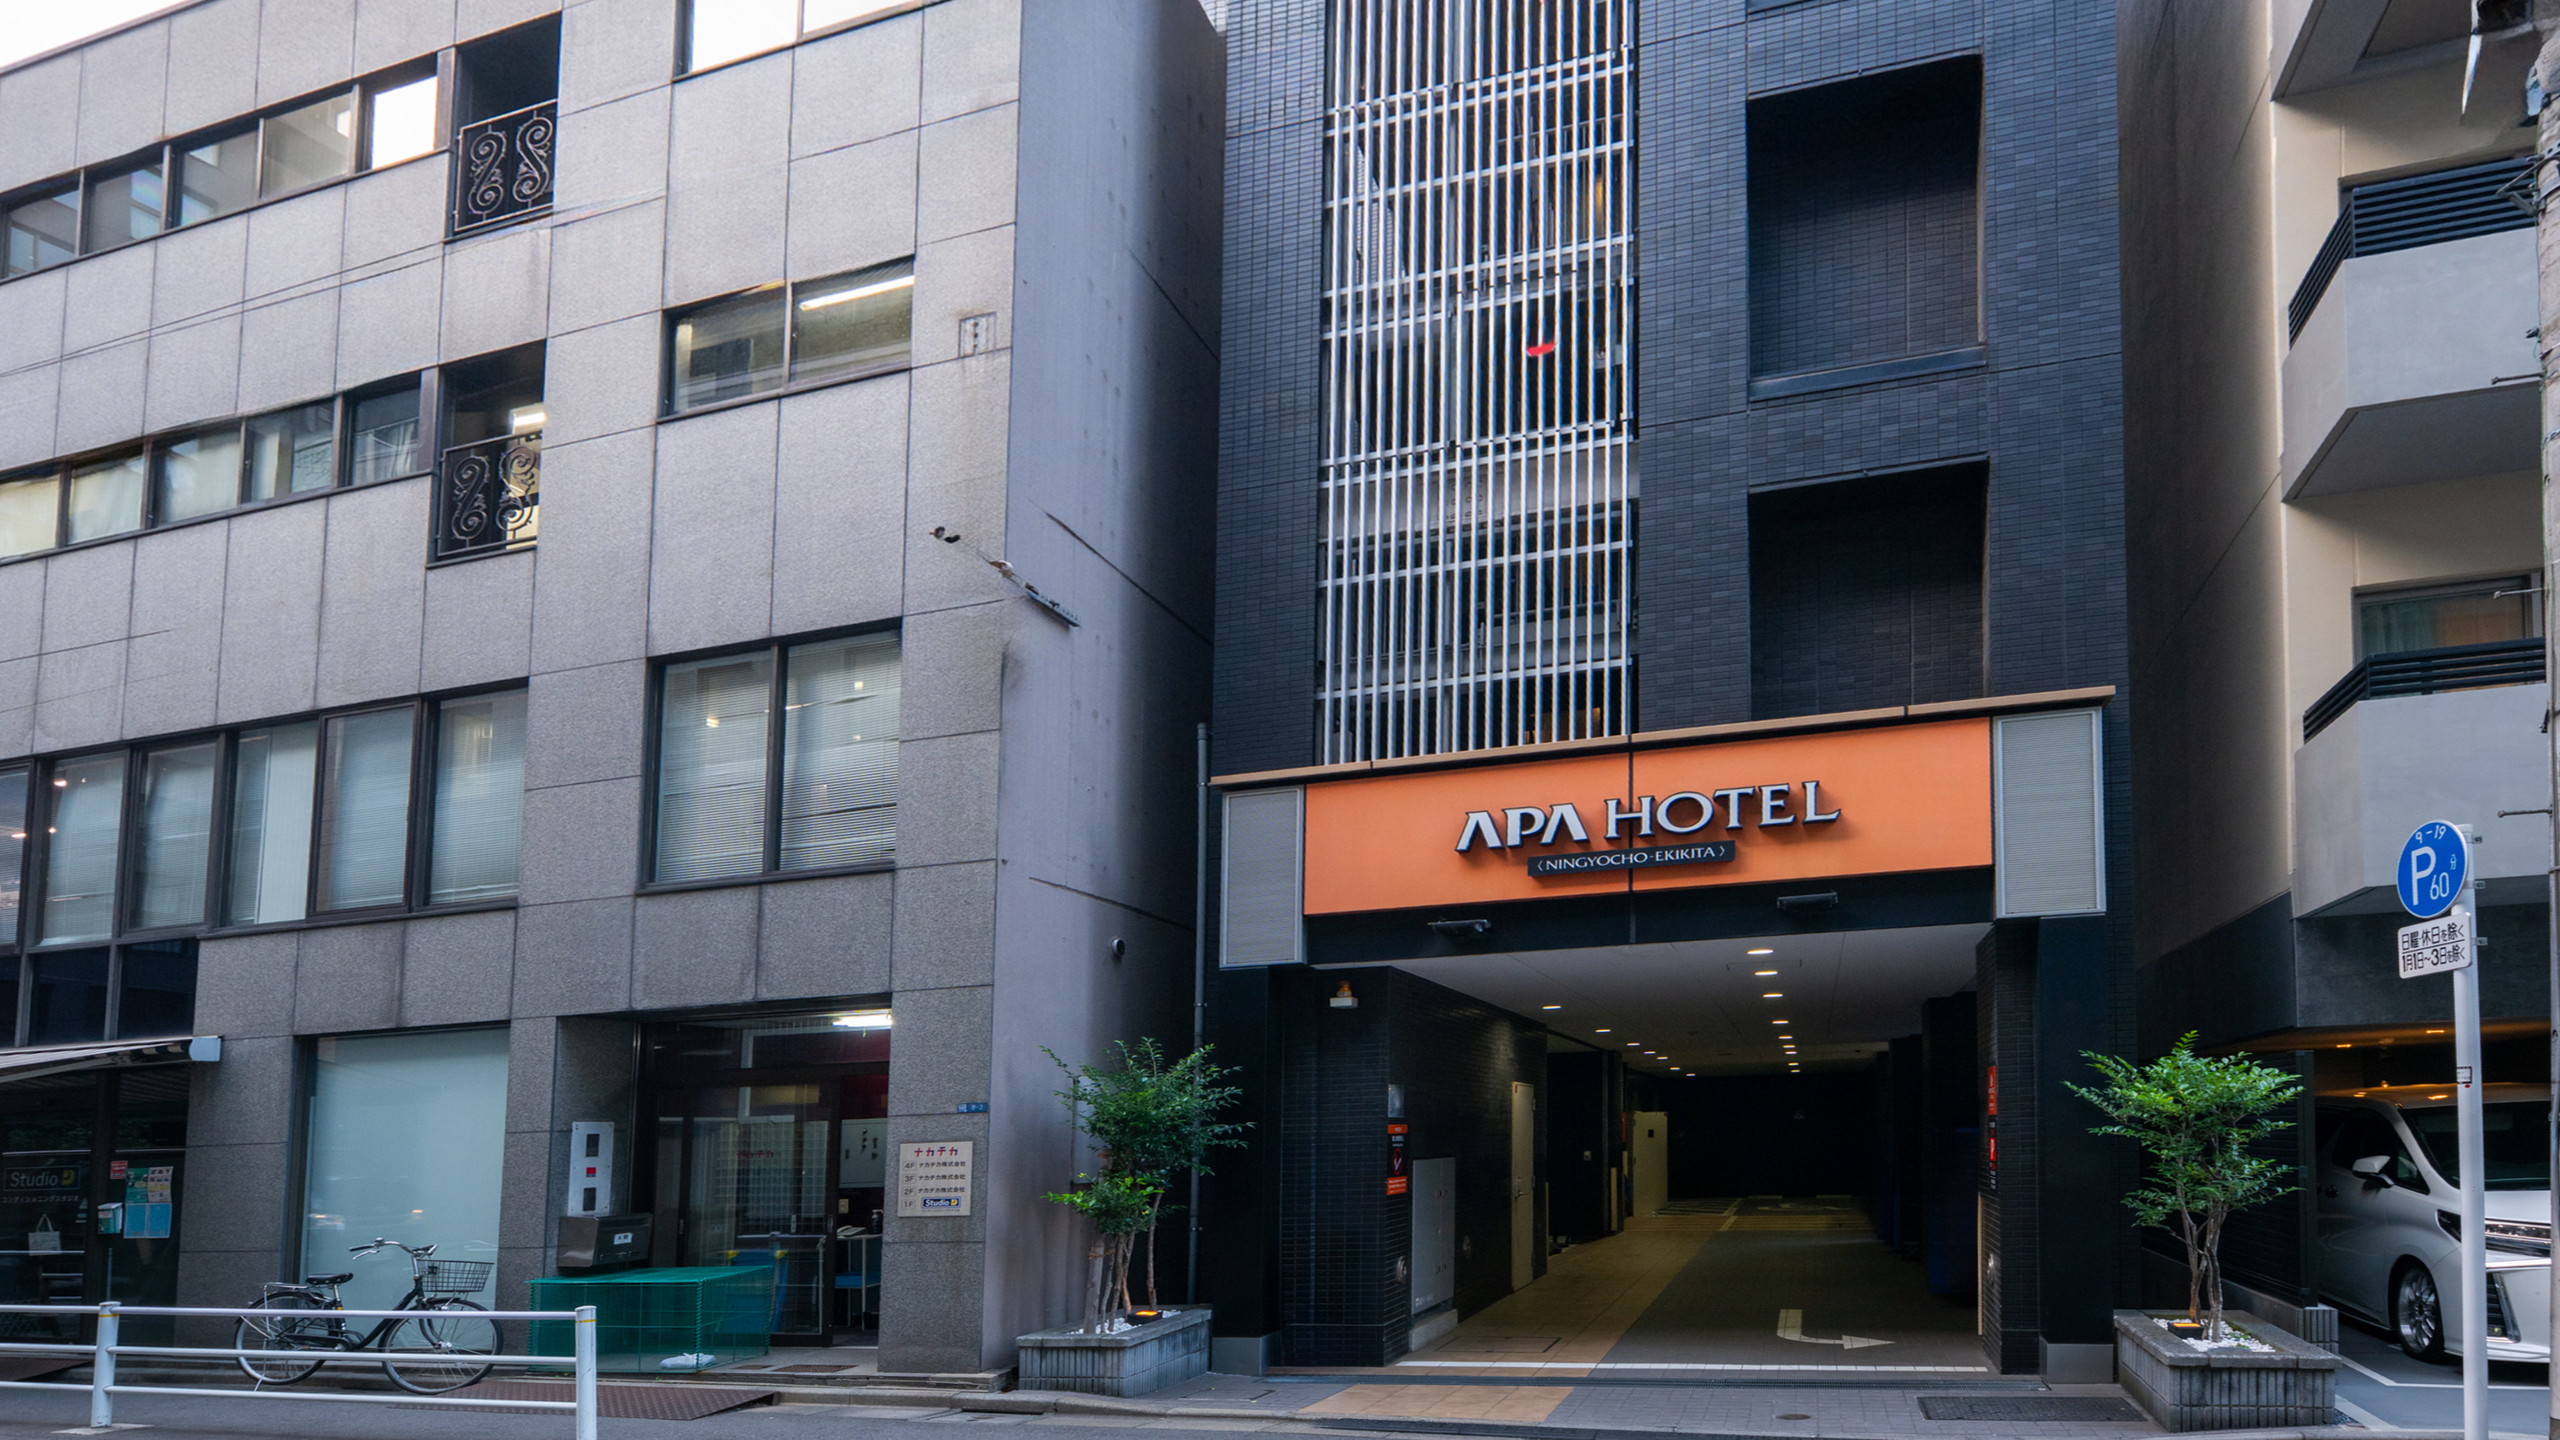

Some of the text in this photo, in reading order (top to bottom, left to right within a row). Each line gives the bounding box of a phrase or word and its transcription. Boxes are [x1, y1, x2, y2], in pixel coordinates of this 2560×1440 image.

[1455, 780, 1841, 852] APA HOTEL
[2415, 825, 2447, 844] 9-19
[2411, 846, 2437, 906] P
[2430, 872, 2450, 900] 60
[914, 1146, 958, 1157] ナカチカ
[10, 1170, 59, 1188] Studio
[925, 1199, 950, 1207] Studio
